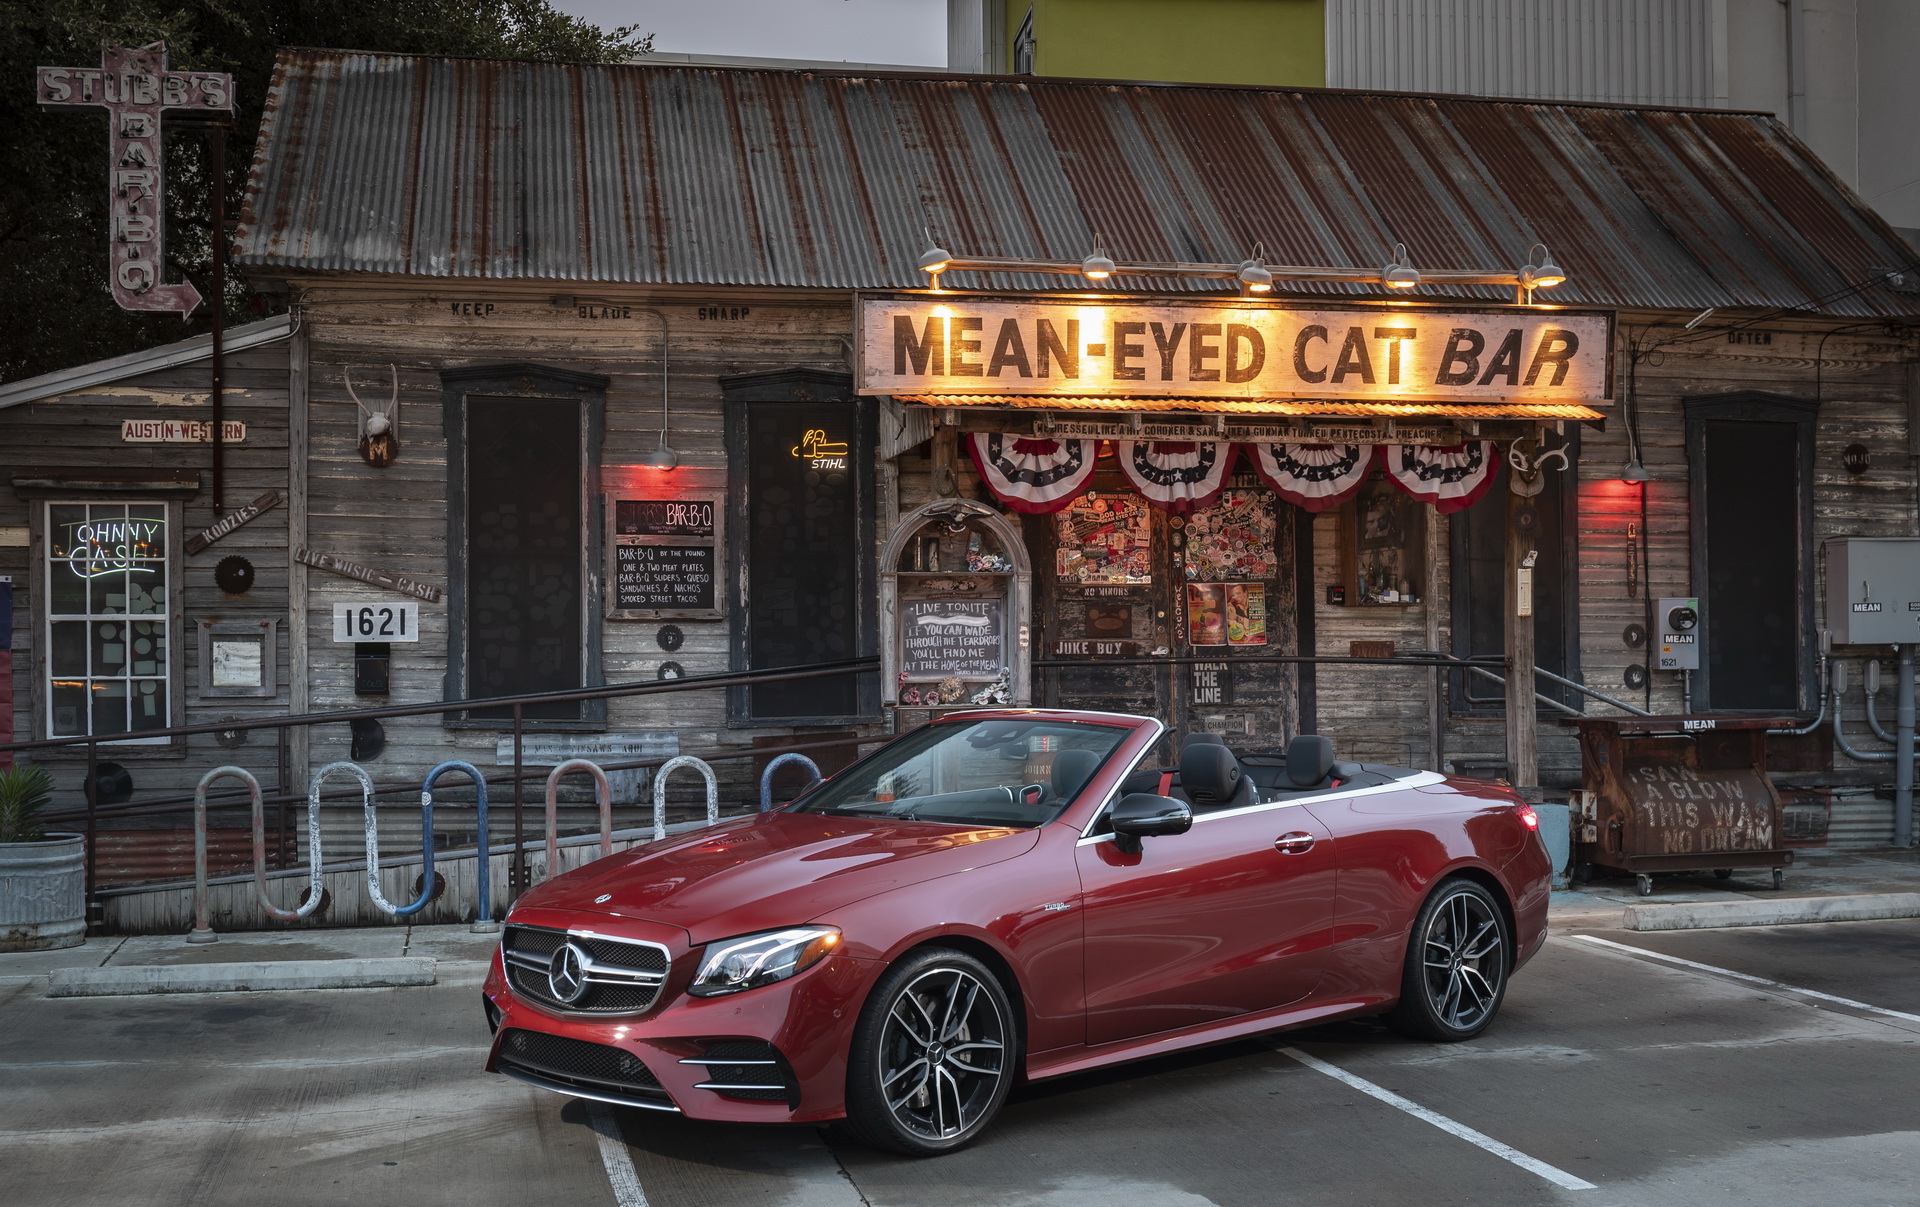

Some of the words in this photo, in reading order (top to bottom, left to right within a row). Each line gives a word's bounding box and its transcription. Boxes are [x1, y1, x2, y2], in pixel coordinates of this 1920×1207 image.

[43, 69, 227, 107] STUBB'S
[451, 302, 494, 316] KEEP
[699, 307, 750, 320] SHARP
[1728, 331, 1772, 346] OFTEN
[893, 315, 1266, 384] MEAN-EYED
[1292, 324, 1418, 385] CAT
[1434, 328, 1580, 387] BAR
[126, 423, 242, 439] AUSTIN-WESTRN
[1095, 424, 1116, 435] LIKE
[1119, 425, 1125, 435] A
[1144, 426, 1185, 437] CORONER
[1188, 427, 1195, 436] &
[812, 459, 845, 469] STIHL
[666, 503, 712, 527] BAR-B-Q
[203, 503, 259, 543] KOOZIES
[54, 521, 159, 557] JOHNNY
[70, 545, 155, 577] CASH
[619, 548, 654, 561] BAR-B-Q
[295, 548, 327, 567] LIVE
[333, 560, 375, 583] MUSIC
[397, 577, 436, 601] CASH
[623, 563, 636, 572] ONE
[639, 563, 645, 572] &
[647, 563, 660, 572] TWO
[662, 564, 678, 572] MEAT
[682, 564, 704, 572] PLATES
[620, 584, 660, 593] SANDWICHES
[663, 584, 669, 592] &
[674, 584, 701, 593] NACHOS
[1084, 588, 1095, 596] NO
[1100, 588, 1129, 596] MINORS
[620, 595, 646, 603] SMOKED
[650, 595, 672, 603] STREET
[677, 595, 698, 603] TACOS
[915, 603, 941, 616] LIVE
[946, 602, 990, 616] TONITE
[1854, 604, 1881, 612] MEAN
[346, 607, 406, 637] 1621
[924, 625, 942, 636] YOU
[944, 625, 962, 636] CAN
[965, 626, 992, 636] WADE
[905, 635, 942, 648] THROUGH
[943, 636, 956, 646] THE
[958, 635, 1001, 647] TEARDROPS
[1664, 634, 1694, 644] MEAN
[912, 647, 941, 659] YOU'LL
[943, 648, 966, 659] FIND
[968, 648, 985, 658] ME
[1056, 642, 1089, 655] JUKE
[1097, 642, 1122, 655] BOX
[904, 661, 917, 671] AT
[920, 660, 940, 671] THE
[941, 660, 960, 671] HOME
[1661, 658, 1677, 667] 1621
[1193, 671, 1218, 687] THE
[1193, 687, 1222, 704] LINE
[1207, 720, 1243, 730] CHAMPION
[1683, 719, 1716, 730] MEAN
[1639, 765, 1699, 783] SAW
[1646, 783, 1664, 800] A
[1668, 780, 1743, 800] GLOW
[1641, 802, 1701, 828] THIS
[1710, 802, 1770, 828] WAS
[1661, 829, 1694, 855] NO
[1700, 825, 1774, 852] DREAM
